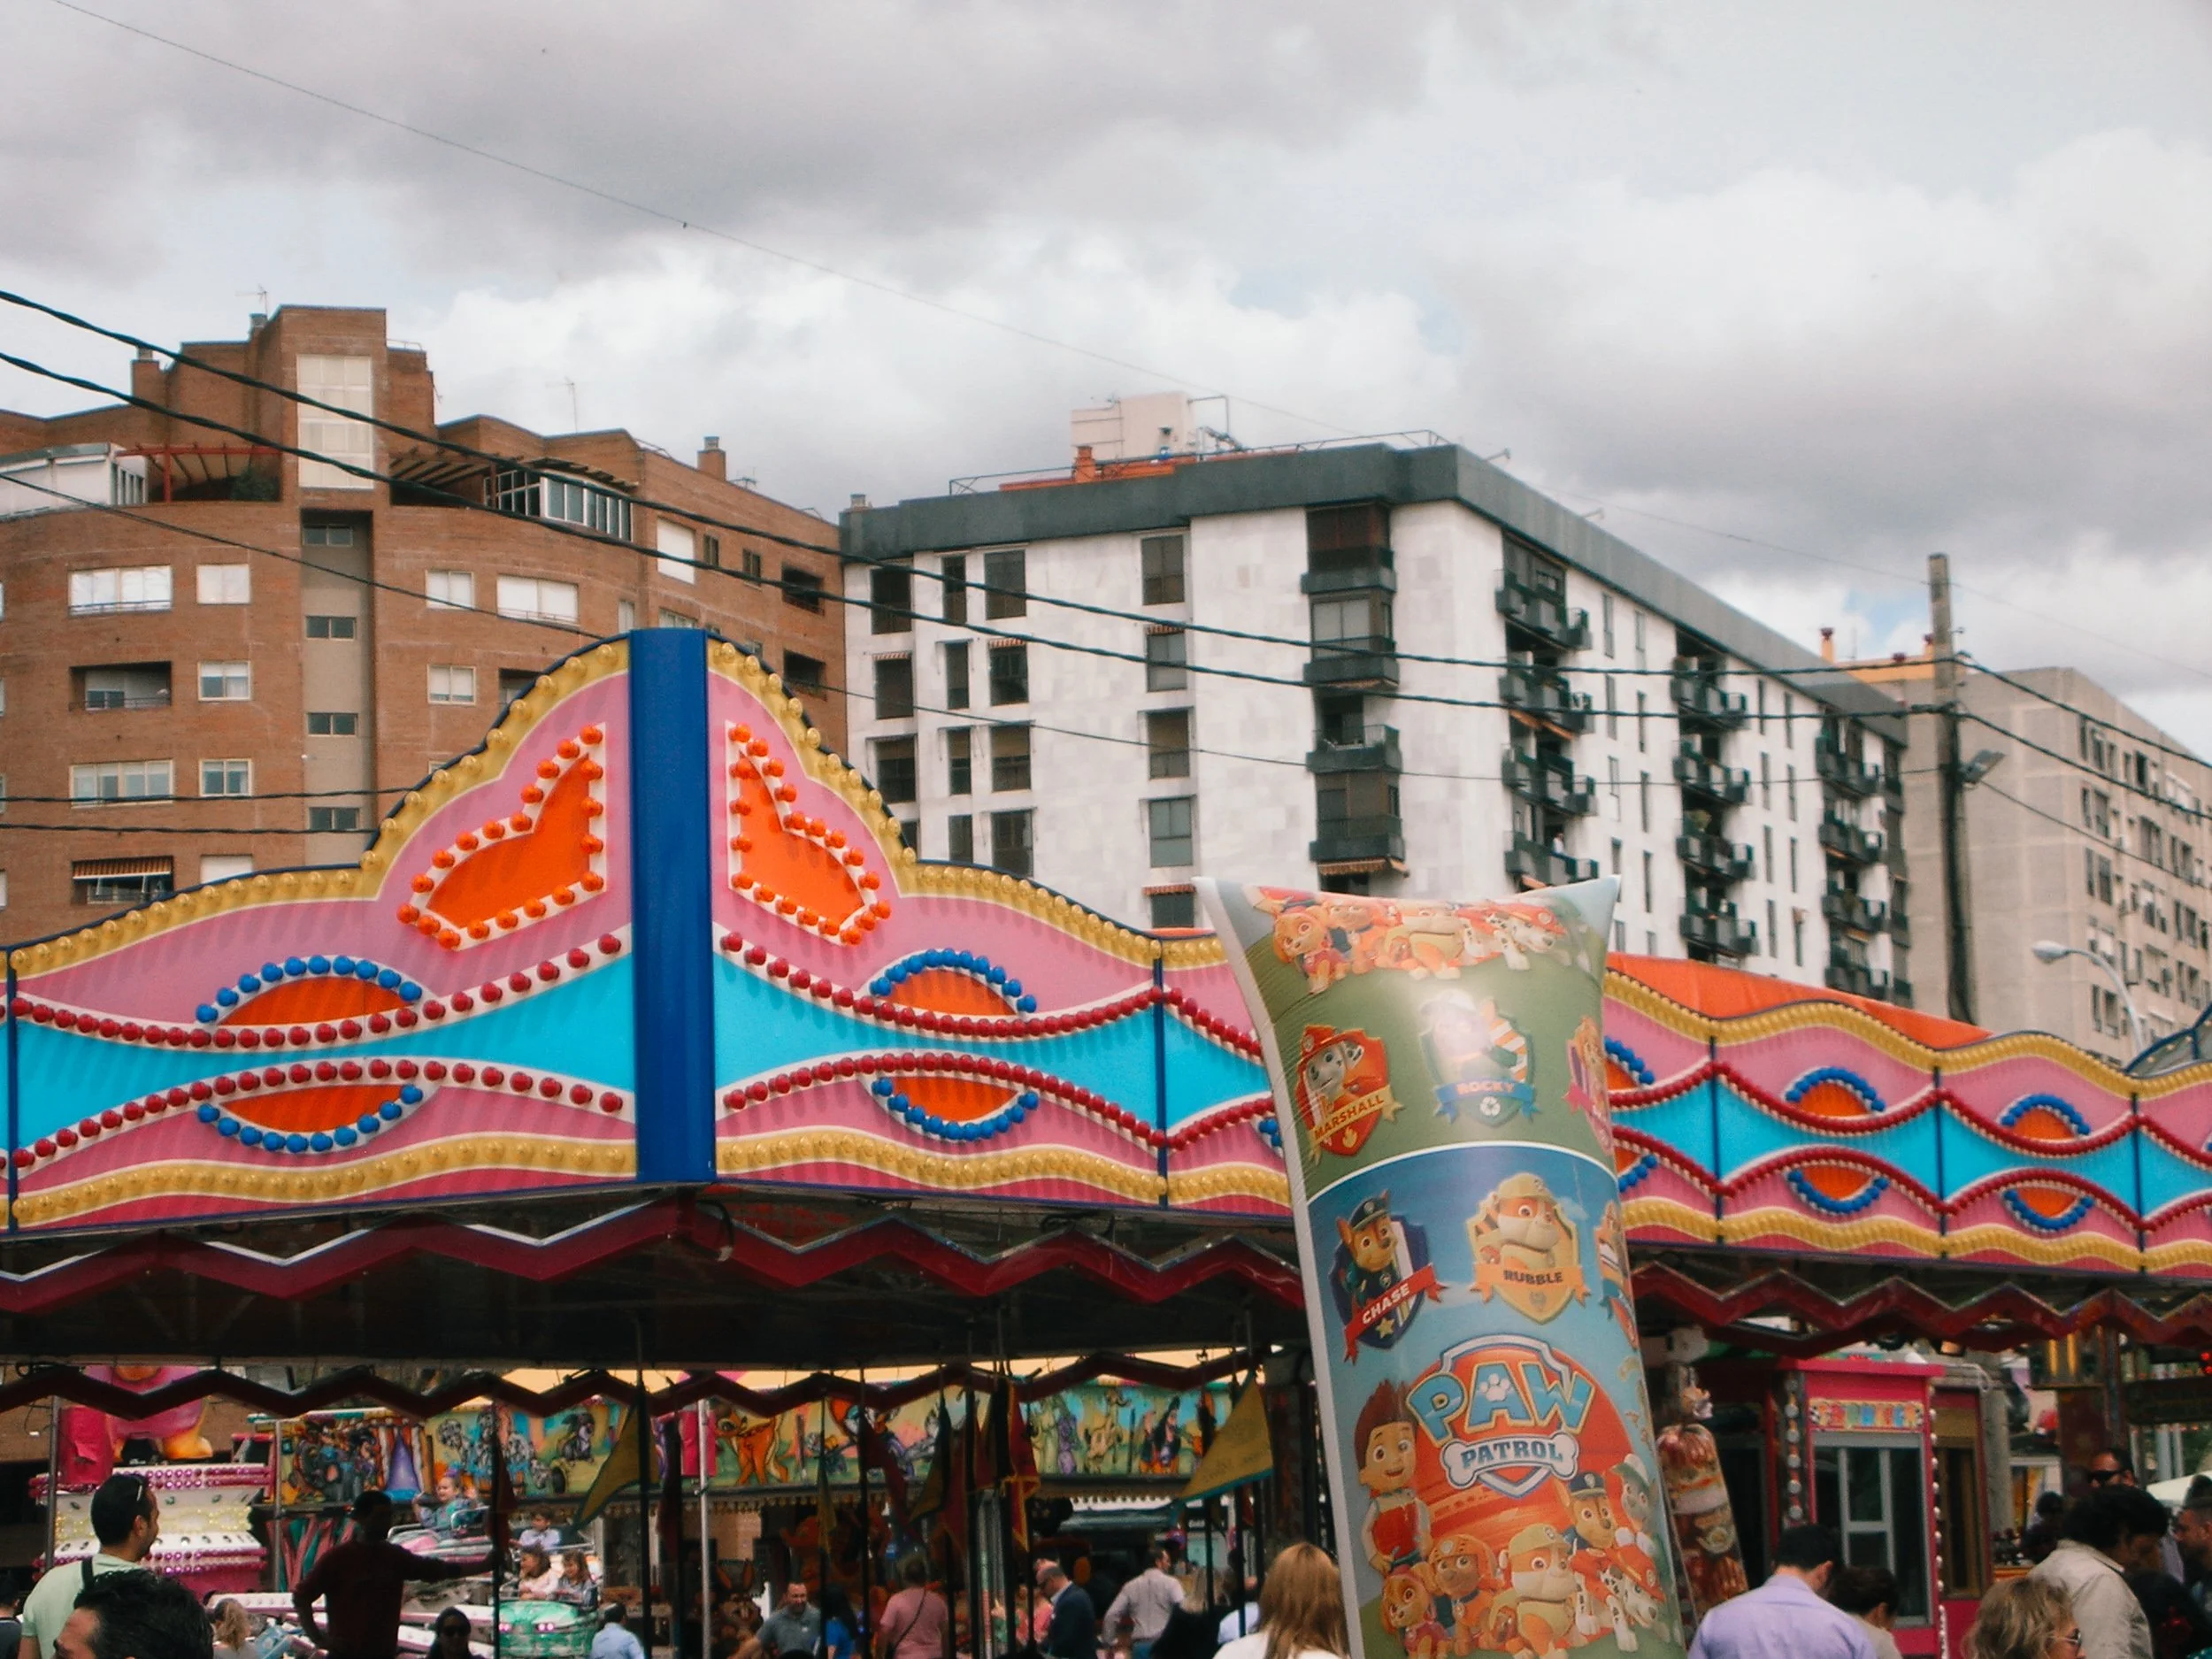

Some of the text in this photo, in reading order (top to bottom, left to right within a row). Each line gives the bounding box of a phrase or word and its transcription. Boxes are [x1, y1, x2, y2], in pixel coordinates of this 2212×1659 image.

[1315, 1095, 1385, 1140] MARSHALL
[1503, 1270, 1563, 1286] RUBBLE
[1363, 1283, 1409, 1324] CHASE
[1407, 1361, 1595, 1448] PAW
[1461, 1440, 1563, 1469] PATROL
